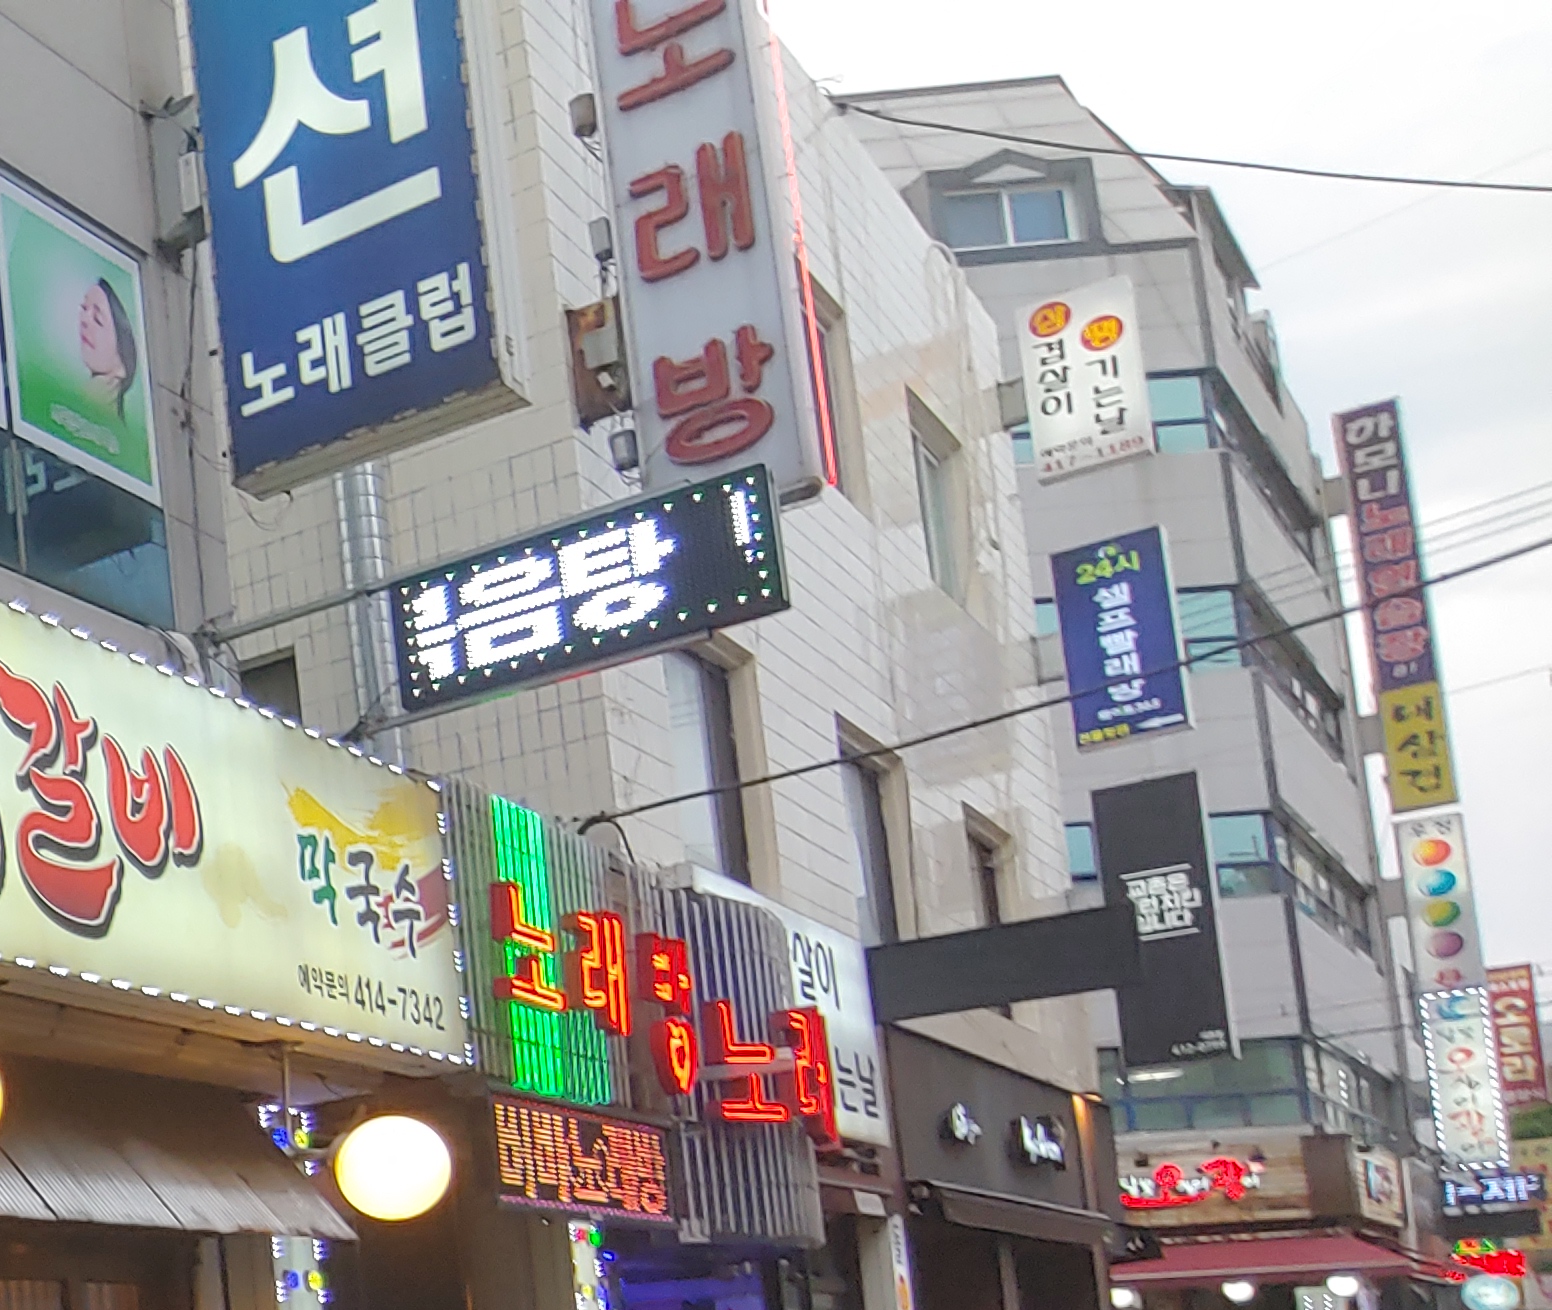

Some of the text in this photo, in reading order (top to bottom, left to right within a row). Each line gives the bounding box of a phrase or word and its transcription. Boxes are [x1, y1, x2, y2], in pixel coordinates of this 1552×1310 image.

[616, 0, 775, 466] 노래방
[240, 261, 477, 418] 노래클럽
[1076, 550, 1141, 585] 24시
[297, 833, 422, 958] 막국수
[298, 964, 445, 1031] 예약문의 414-7342
